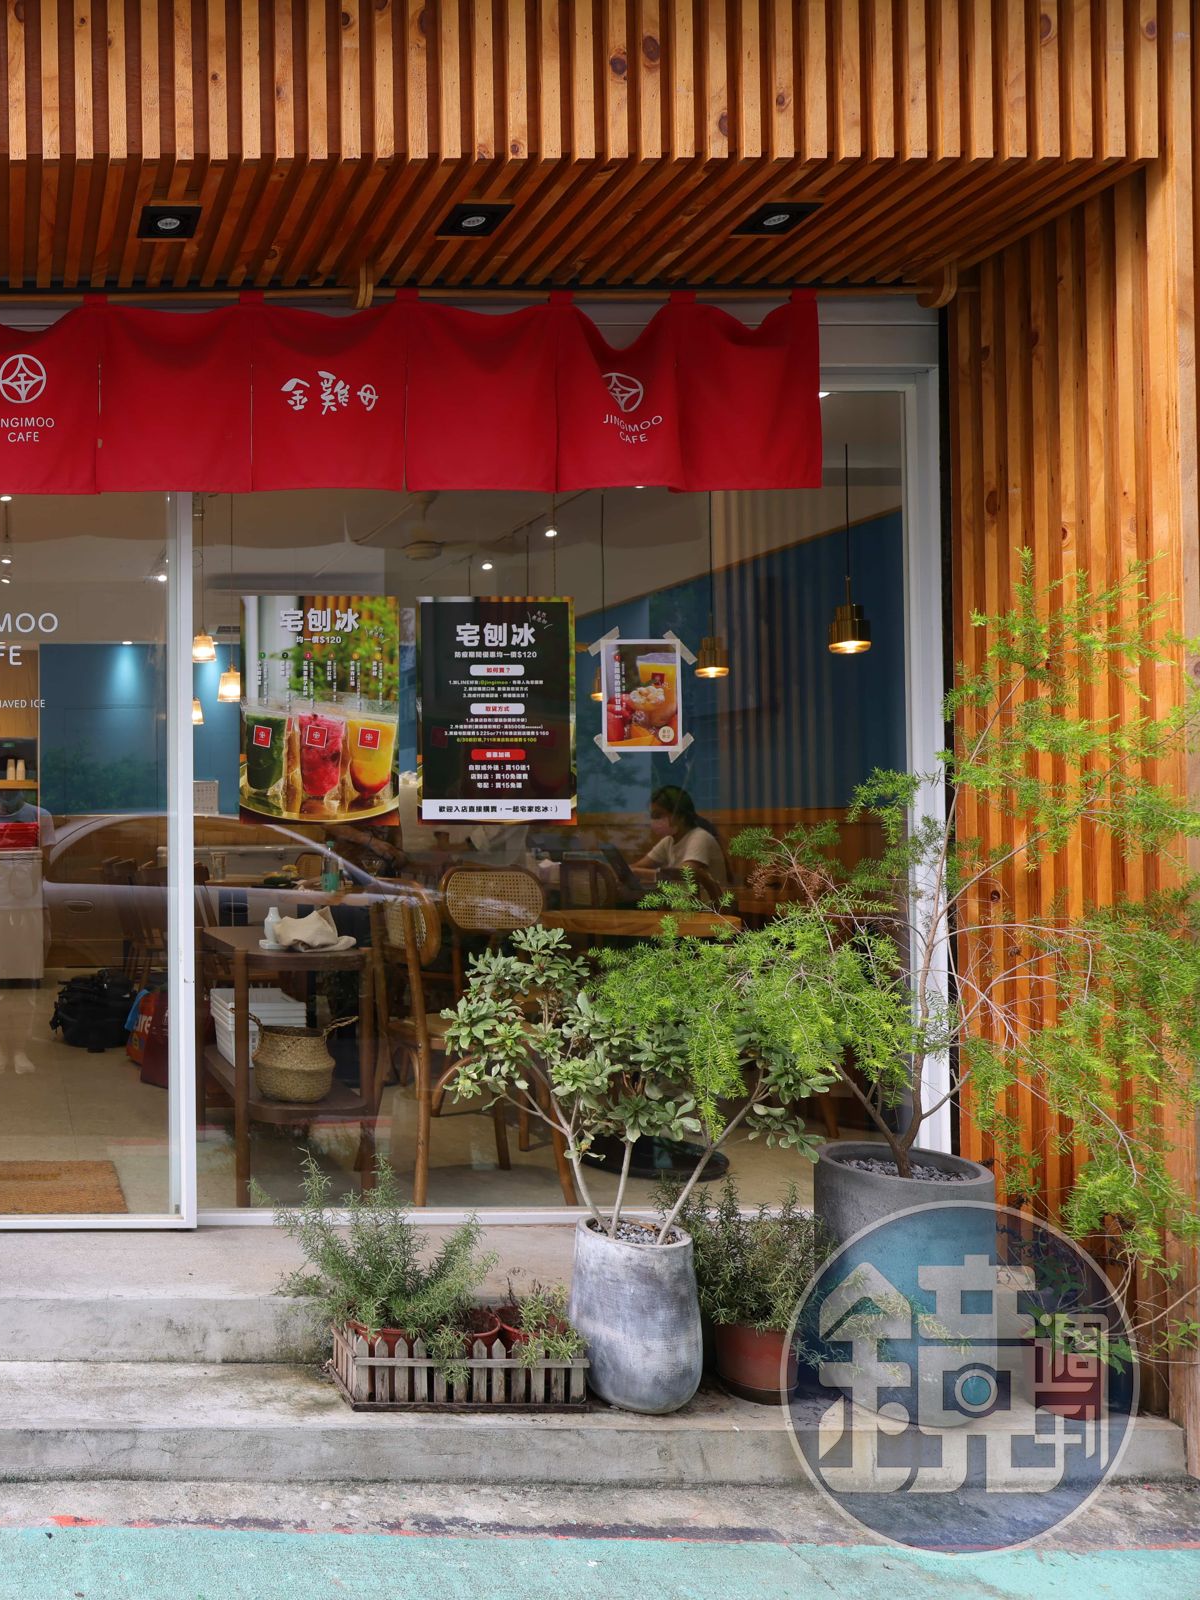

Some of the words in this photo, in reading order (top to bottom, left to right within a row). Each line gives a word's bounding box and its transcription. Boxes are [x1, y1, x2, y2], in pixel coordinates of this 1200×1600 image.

[603, 414, 663, 432] JINGIMOO
[7, 431, 39, 443] CAFE
[619, 431, 648, 444] CAFE
[280, 608, 360, 632] 宅刨冰
[455, 622, 536, 647] 宅刨冰
[31, 700, 46, 708] ICE
